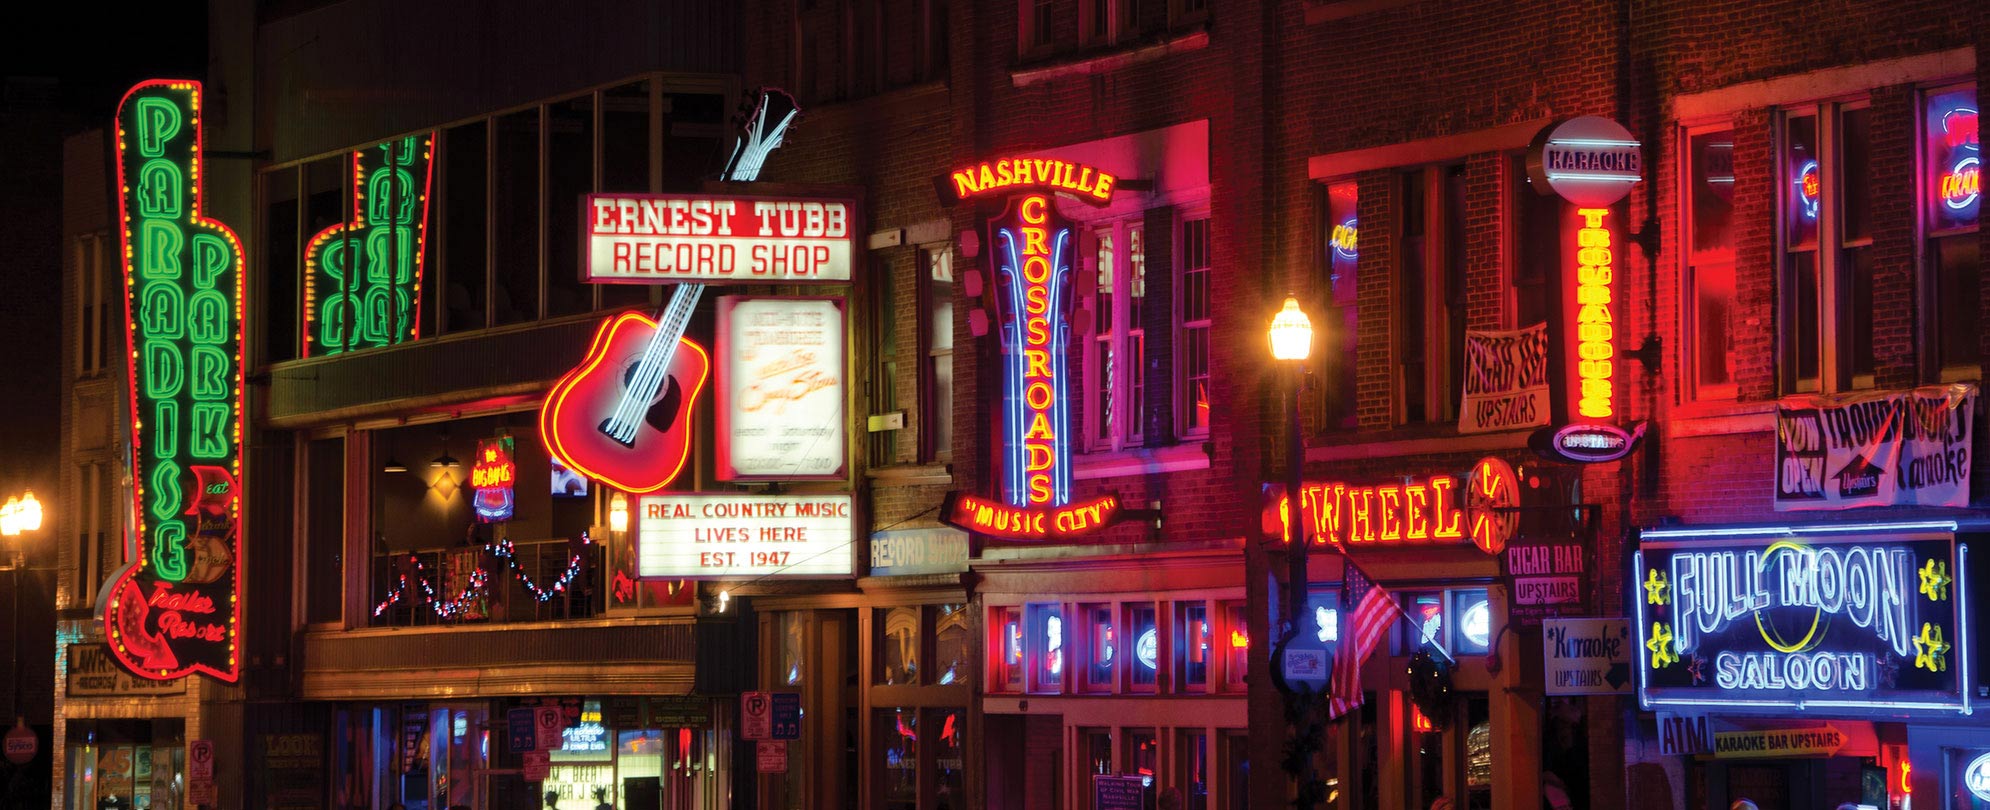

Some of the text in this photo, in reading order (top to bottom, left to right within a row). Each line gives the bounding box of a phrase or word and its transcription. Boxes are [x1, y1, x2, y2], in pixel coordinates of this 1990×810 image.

[1549, 150, 1637, 171] KARAOKE
[953, 159, 1114, 199] NASHVILLE
[594, 198, 845, 238] ERNEST TUBB
[613, 242, 830, 277] RECORD SHOP
[137, 97, 187, 582] PARADISE
[187, 233, 230, 458] PARK
[1021, 196, 1055, 502] CROSSROADS
[1477, 394, 1536, 428] UPSTAIRS
[206, 481, 229, 495] eat
[647, 503, 848, 519] REAL COUNTRY MUSIC
[1308, 478, 1463, 542] WHEEL
[695, 527, 808, 543] LIVES HERE
[871, 532, 967, 568] RECORD SHOP
[700, 551, 790, 567] EST. 1947
[1508, 544, 1584, 575] CIGAR BAR
[1518, 582, 1577, 600] UPSTAIRS
[1672, 547, 1905, 656] FULL MOON
[1555, 670, 1602, 687] UPSTAIRS
[1716, 651, 1867, 691] SALOON
[1662, 716, 1709, 754] ATM
[1715, 732, 1840, 752] KARAOKE BAR UPSTAIRS
